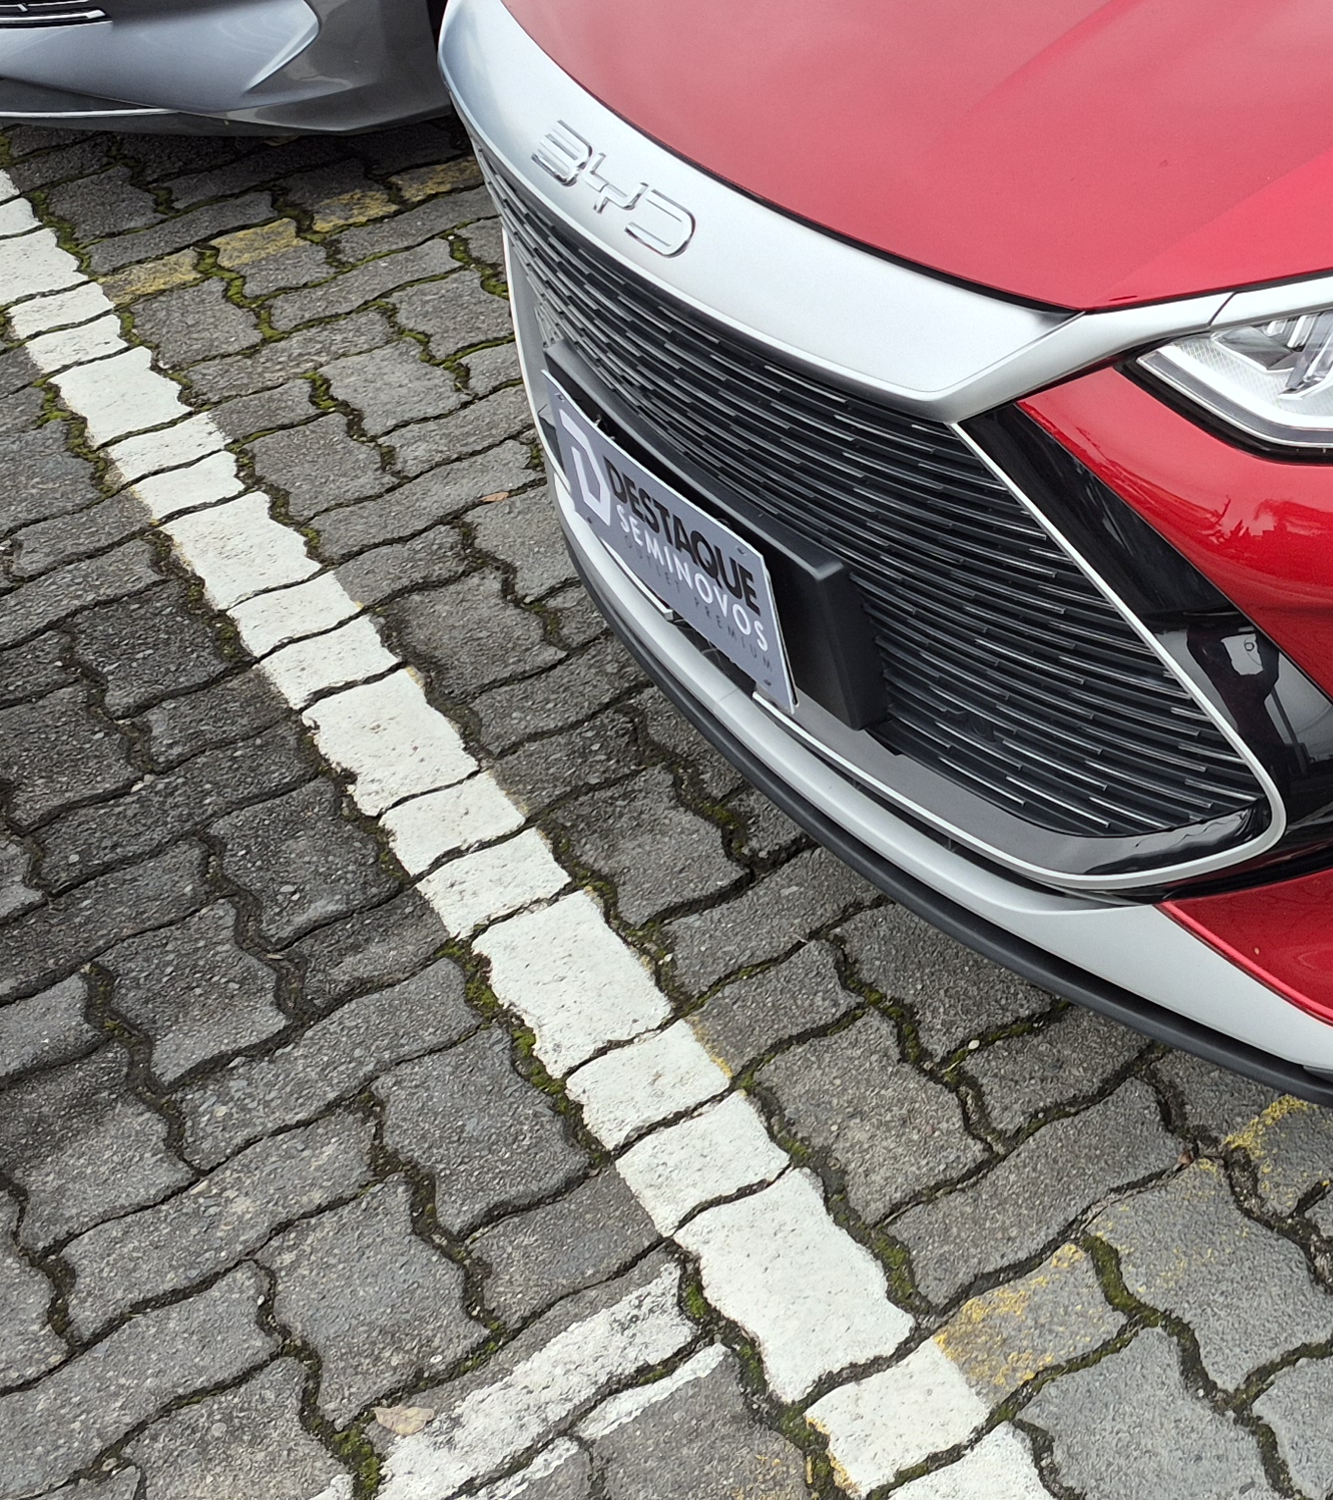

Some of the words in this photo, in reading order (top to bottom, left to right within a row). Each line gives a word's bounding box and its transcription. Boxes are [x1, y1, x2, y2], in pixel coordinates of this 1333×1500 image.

[531, 119, 696, 259] BYD
[602, 455, 762, 617] DESTAQUE
[616, 504, 769, 652] SEMINOVOS
[624, 533, 682, 595] OUTLET
[693, 596, 774, 673] PREMIUM
